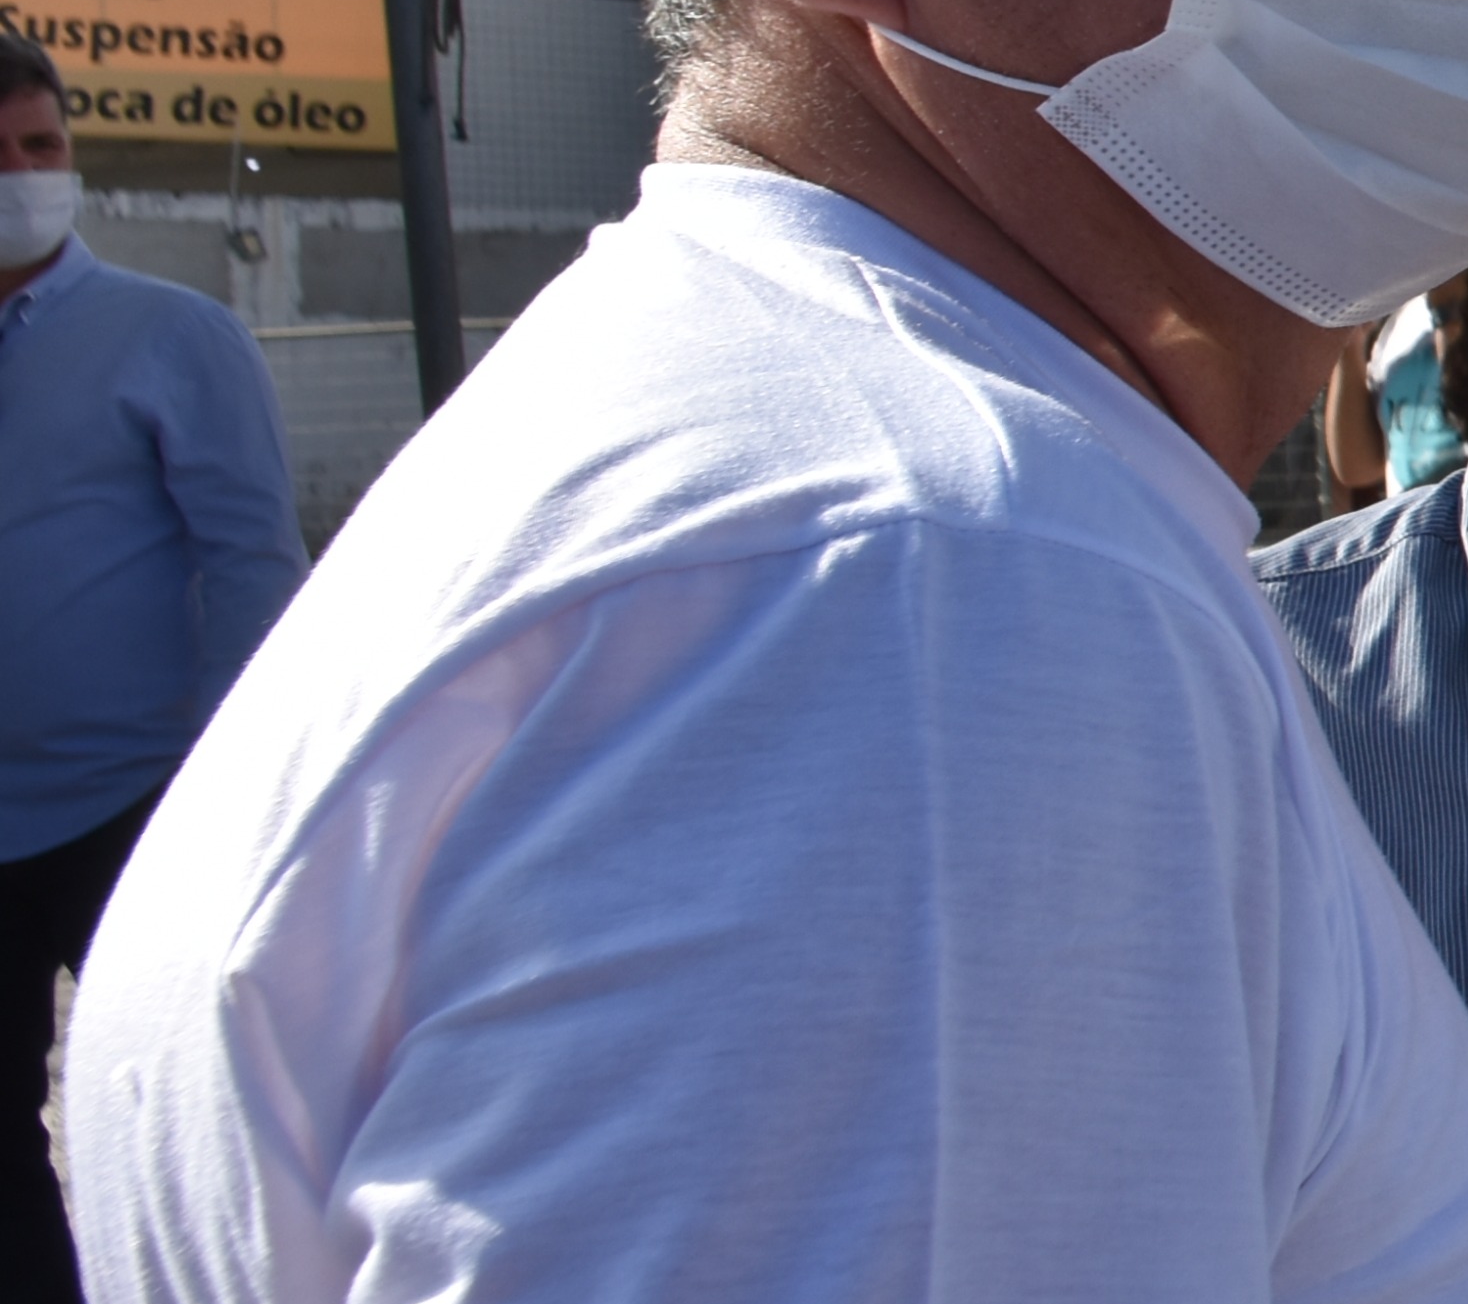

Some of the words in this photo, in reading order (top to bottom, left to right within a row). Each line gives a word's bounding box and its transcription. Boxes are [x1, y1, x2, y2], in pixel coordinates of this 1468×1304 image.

[0, 3, 286, 65] Suspensão
[66, 87, 155, 123] oca
[172, 82, 238, 128] de
